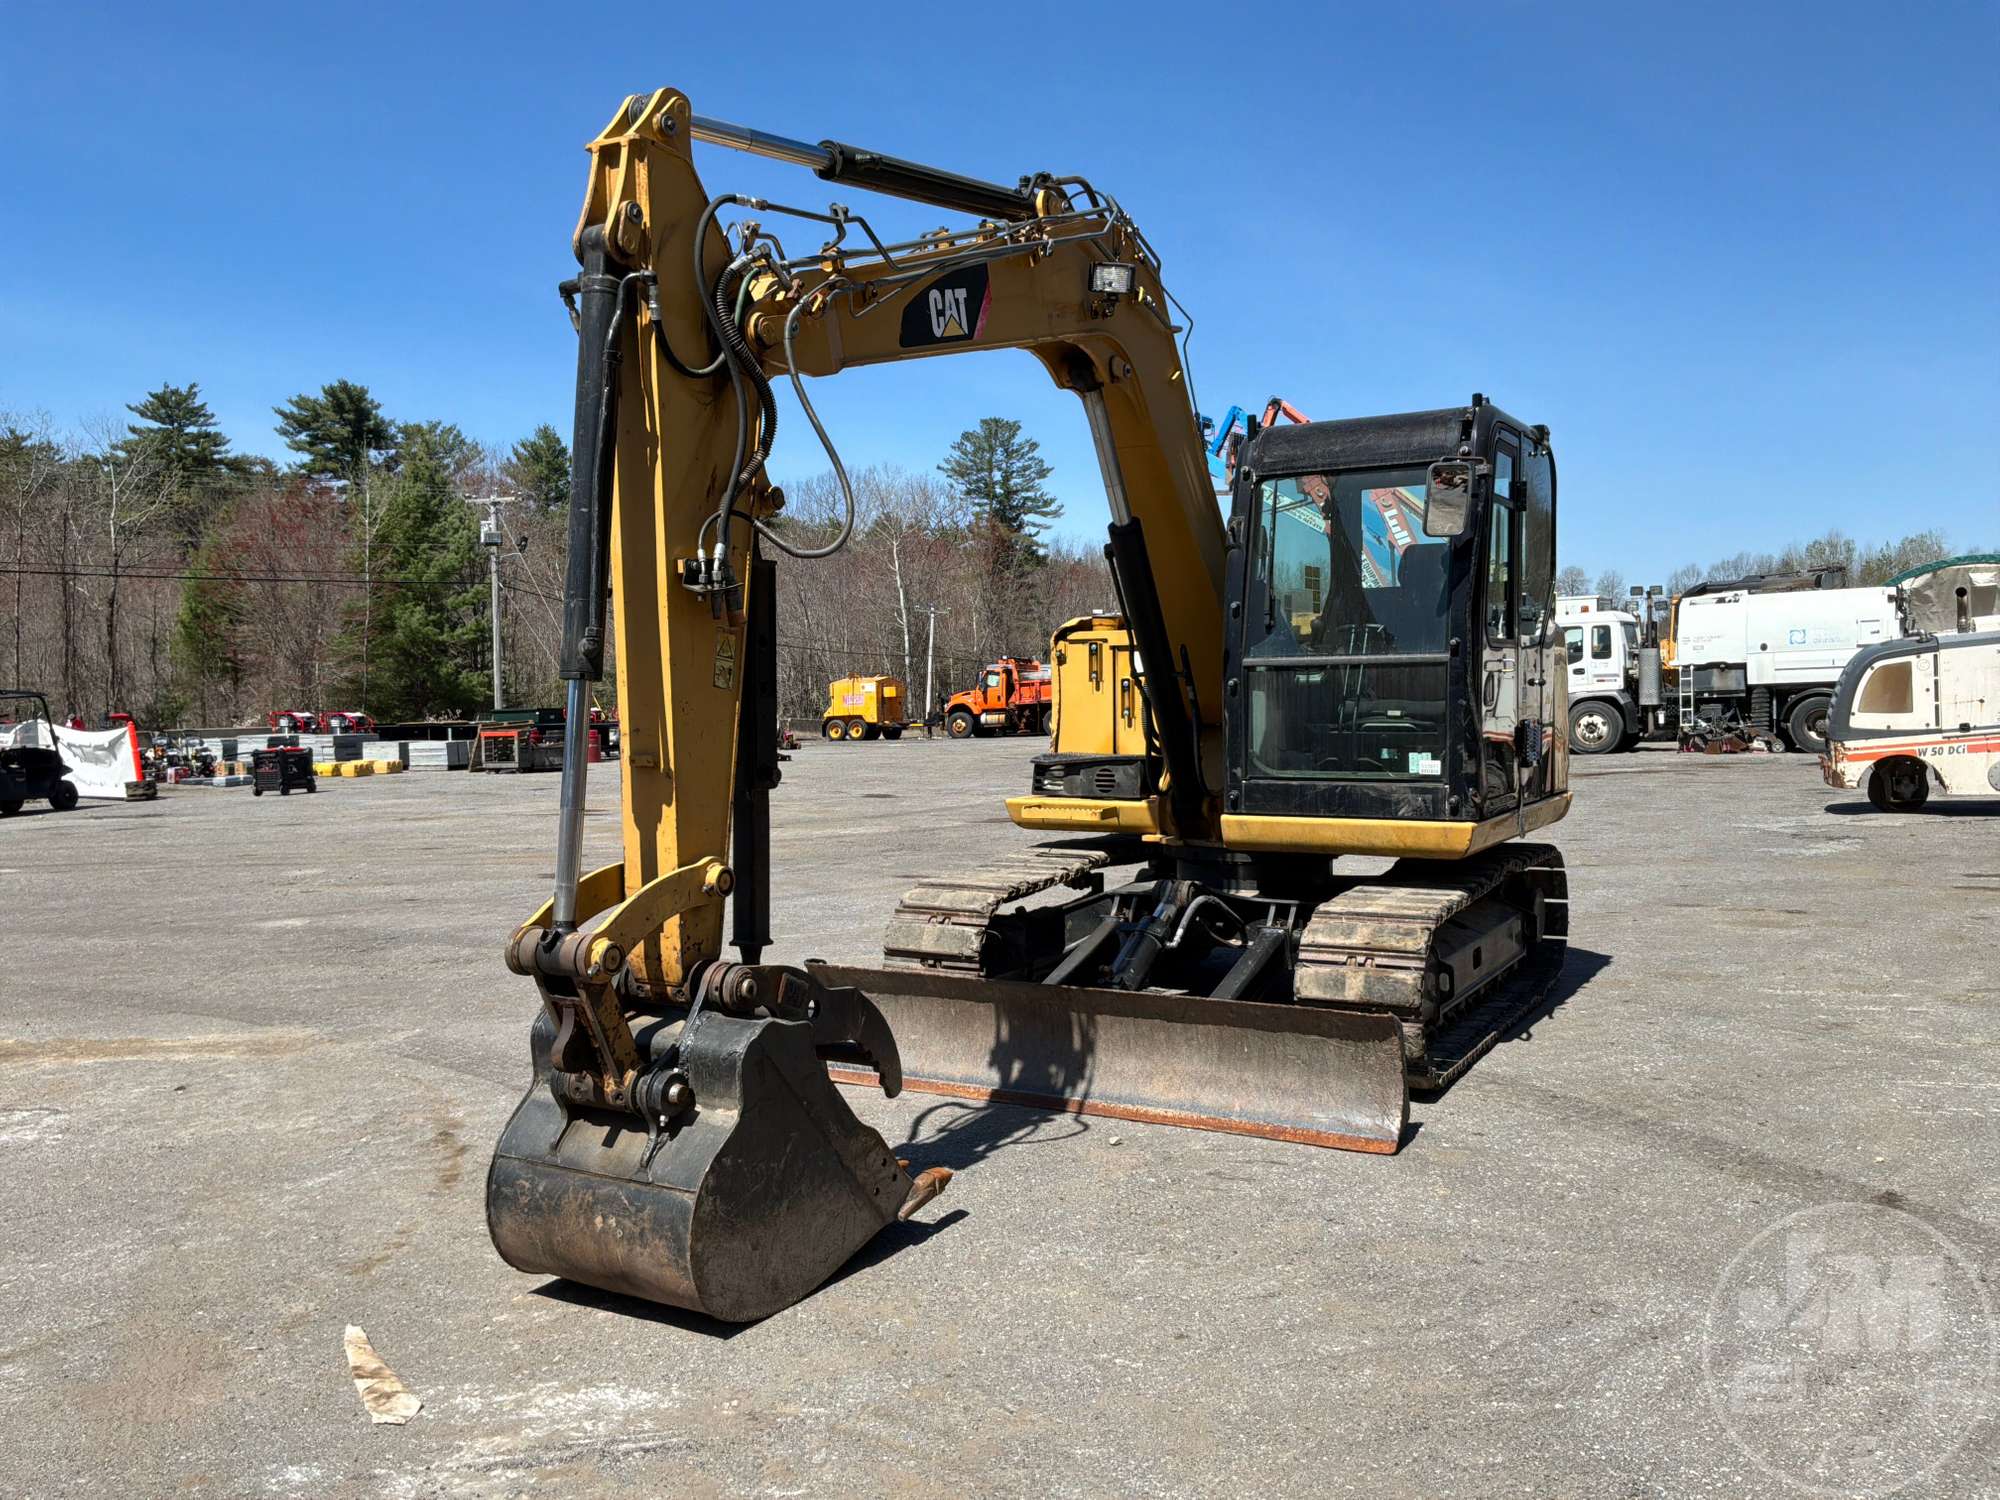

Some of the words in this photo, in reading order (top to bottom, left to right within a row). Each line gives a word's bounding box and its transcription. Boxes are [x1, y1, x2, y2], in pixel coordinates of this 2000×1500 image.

[928, 287, 968, 338] CAT
[1918, 747, 1928, 757] W
[1931, 746, 1944, 757] 50
[1947, 744, 1966, 755] DCi
